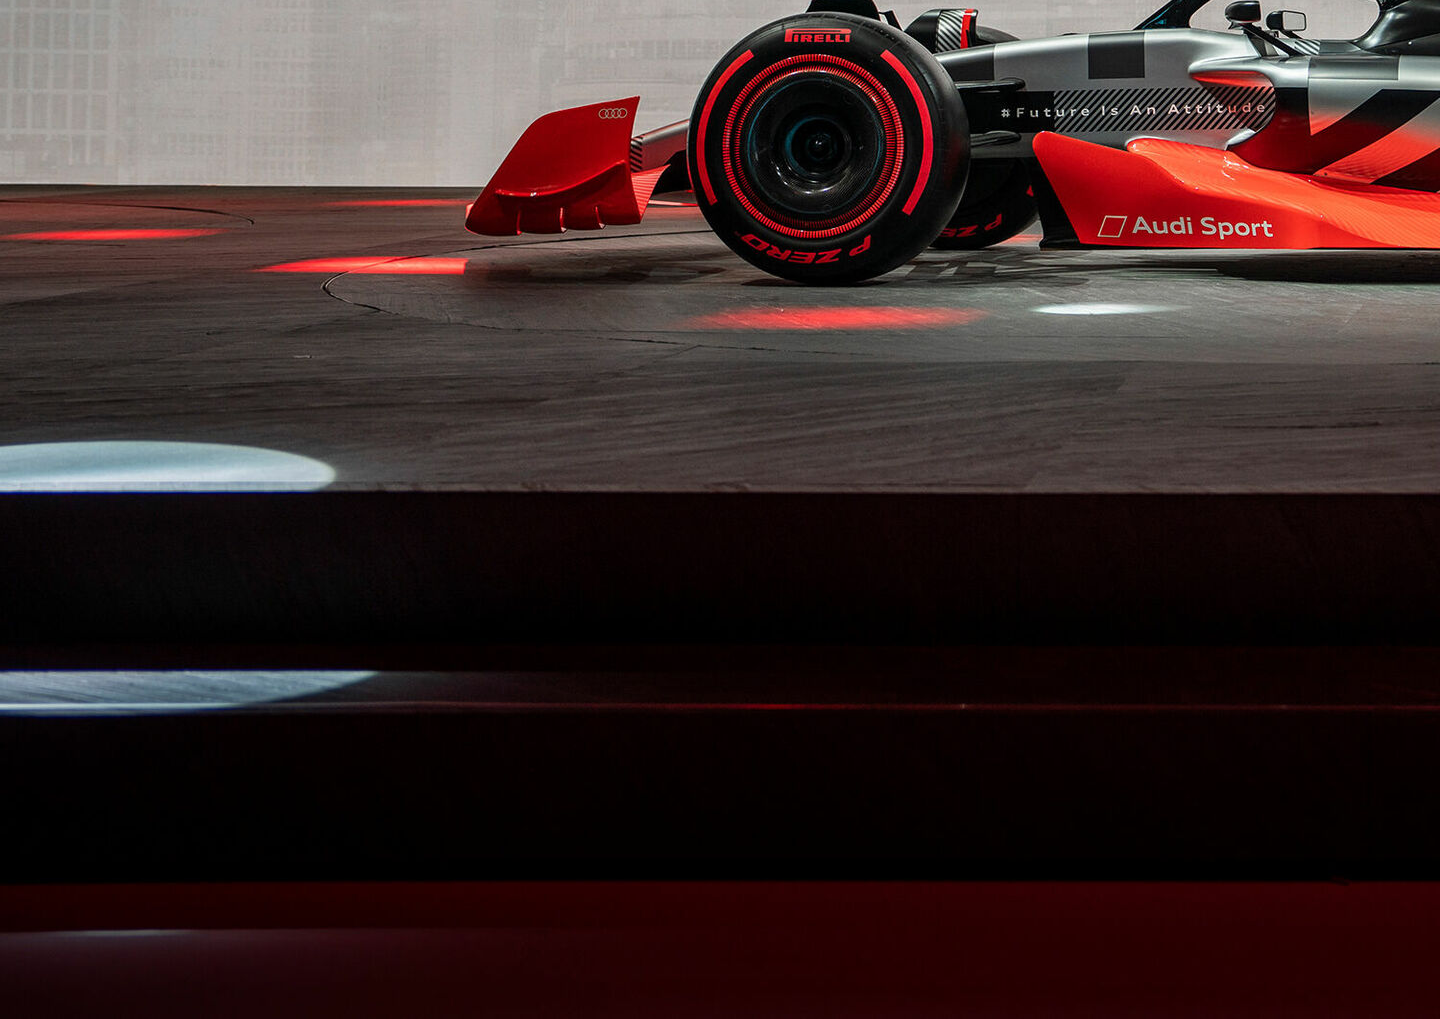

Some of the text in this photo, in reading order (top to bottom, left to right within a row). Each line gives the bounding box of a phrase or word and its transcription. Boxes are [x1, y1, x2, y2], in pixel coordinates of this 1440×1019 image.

[784, 28, 852, 43] PIRELLI
[1001, 102, 1266, 118] #Future Is An Attitude
[1132, 216, 1274, 240] Audi Sport
